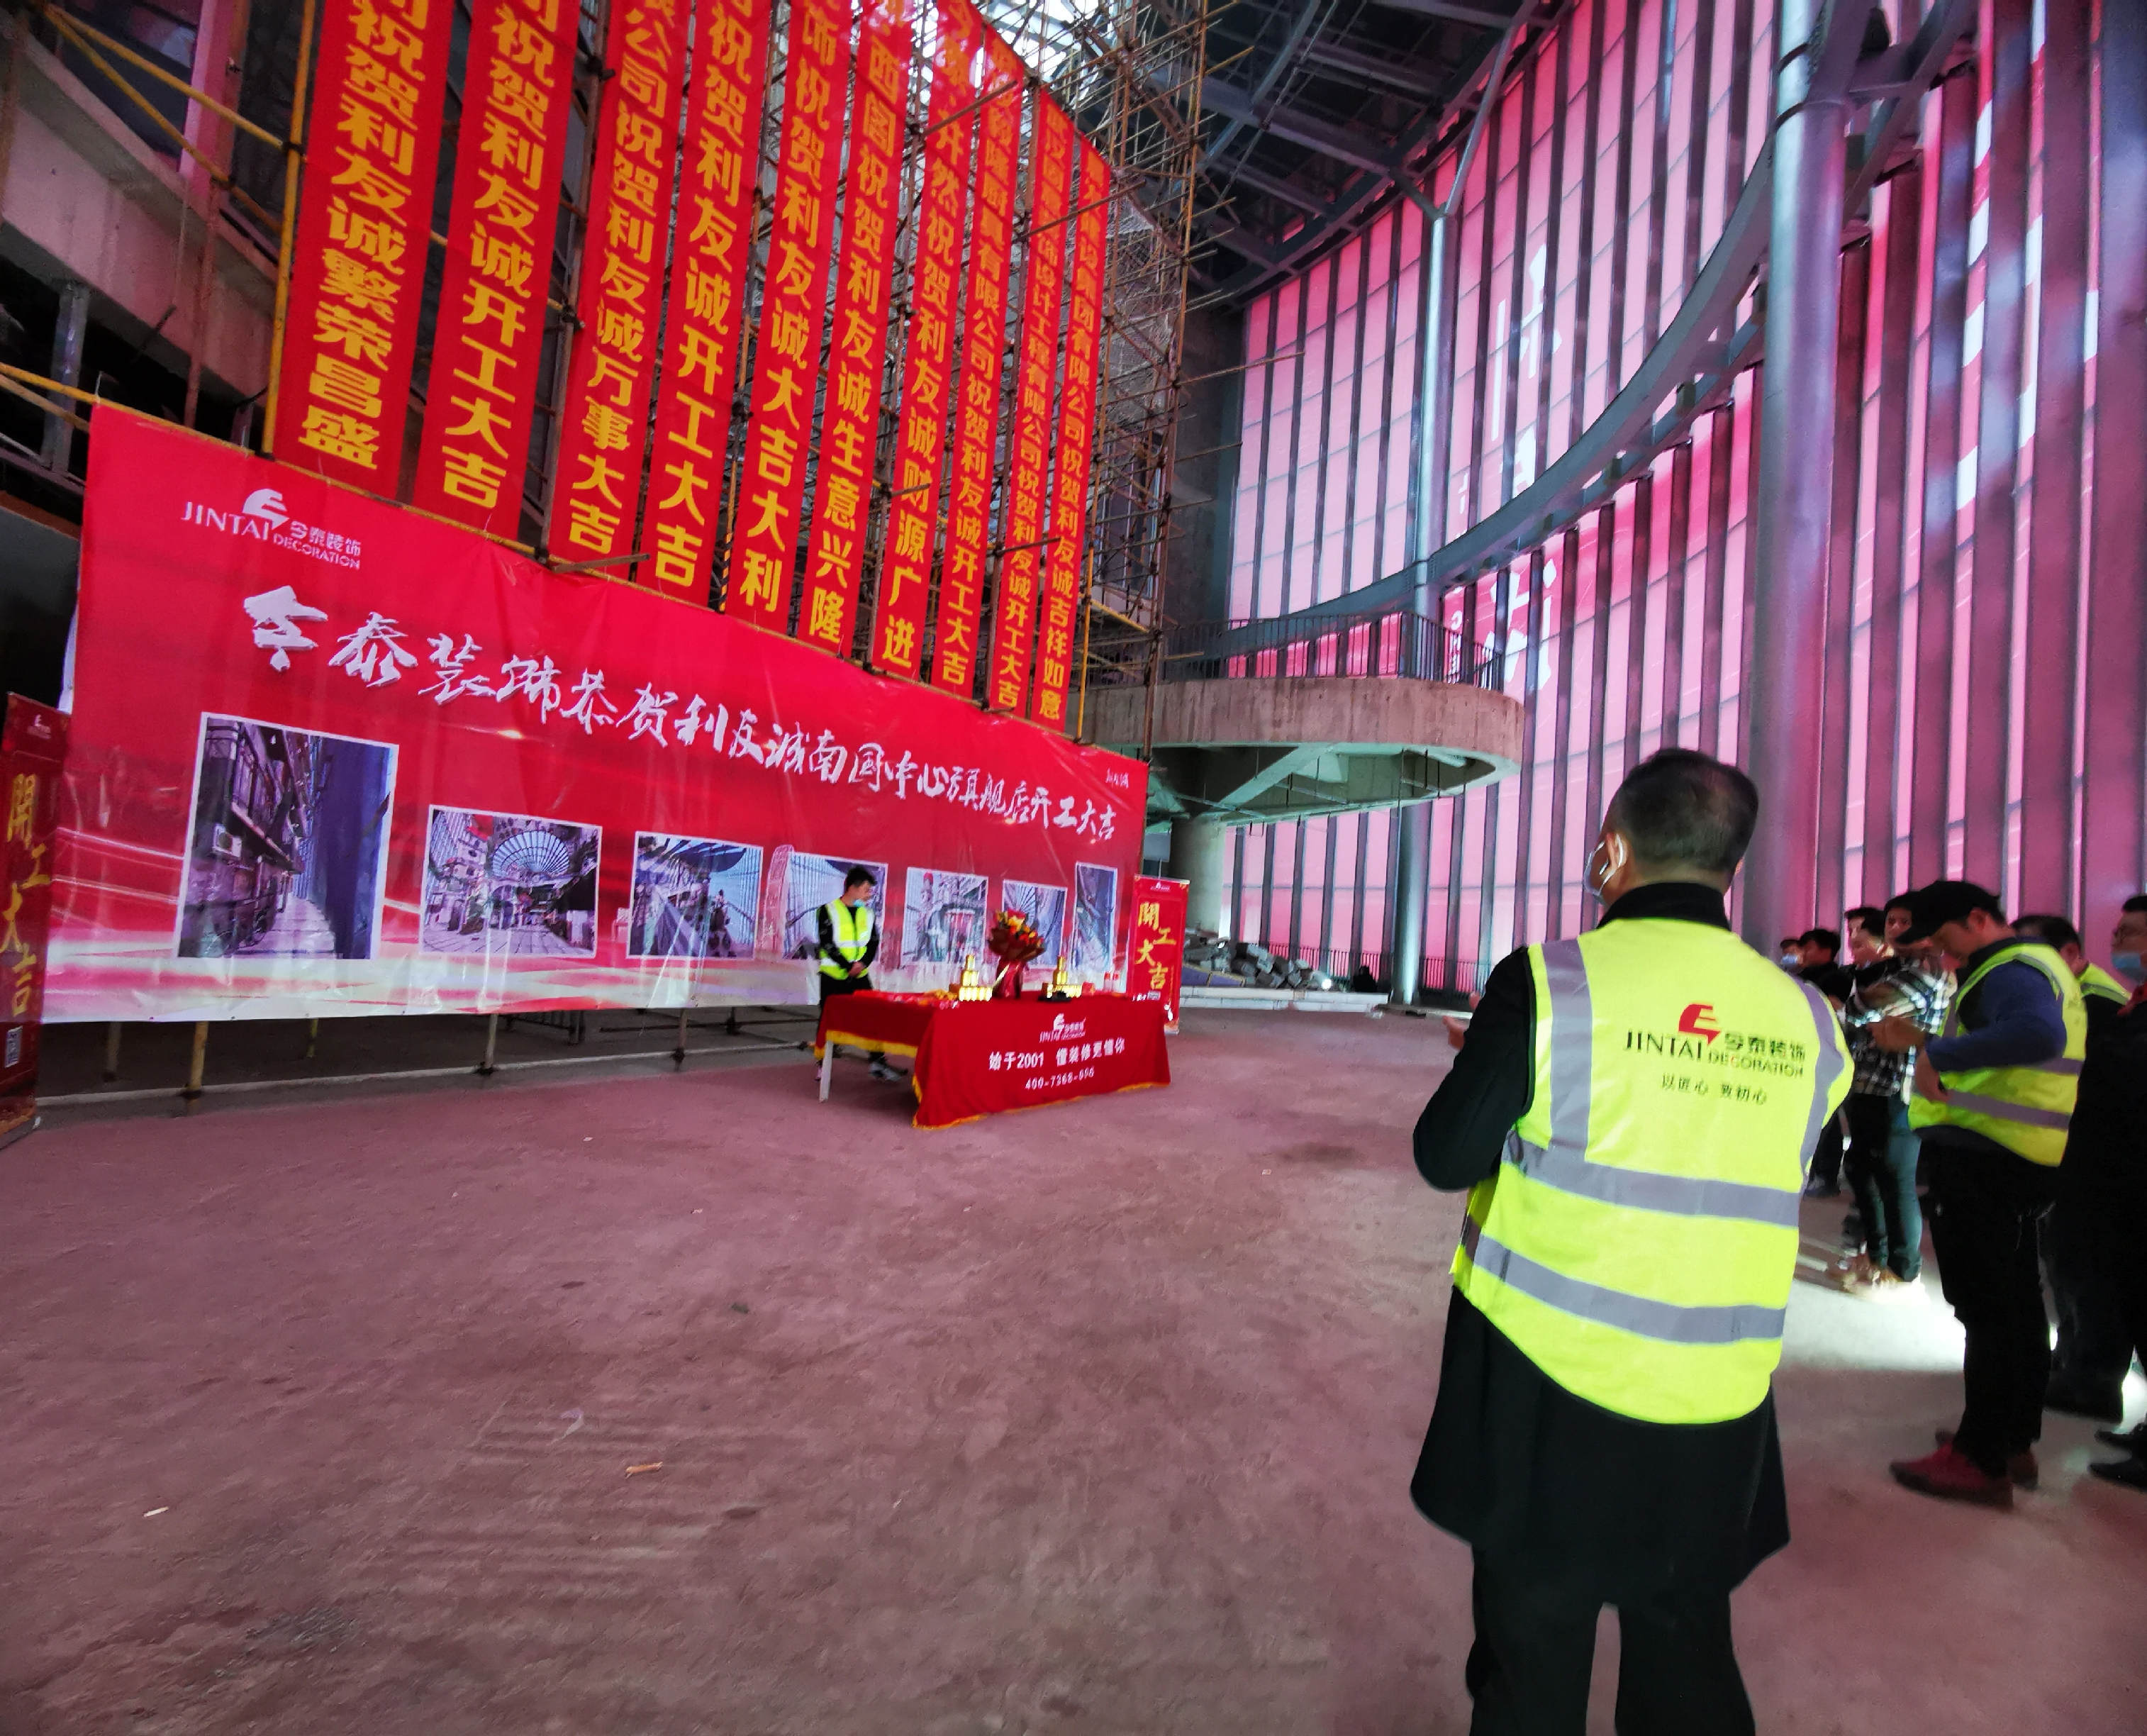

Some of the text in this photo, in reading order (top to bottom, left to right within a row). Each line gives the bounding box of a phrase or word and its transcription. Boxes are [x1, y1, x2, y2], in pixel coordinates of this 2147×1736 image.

[739, 0, 840, 613] 饰祝贺利友诚大吉大利
[182, 501, 269, 540] JINTAI
[273, 533, 360, 569] DECORATION
[1623, 1030, 1702, 1062] JINTAI
[1707, 1050, 1805, 1079] DECORATION
